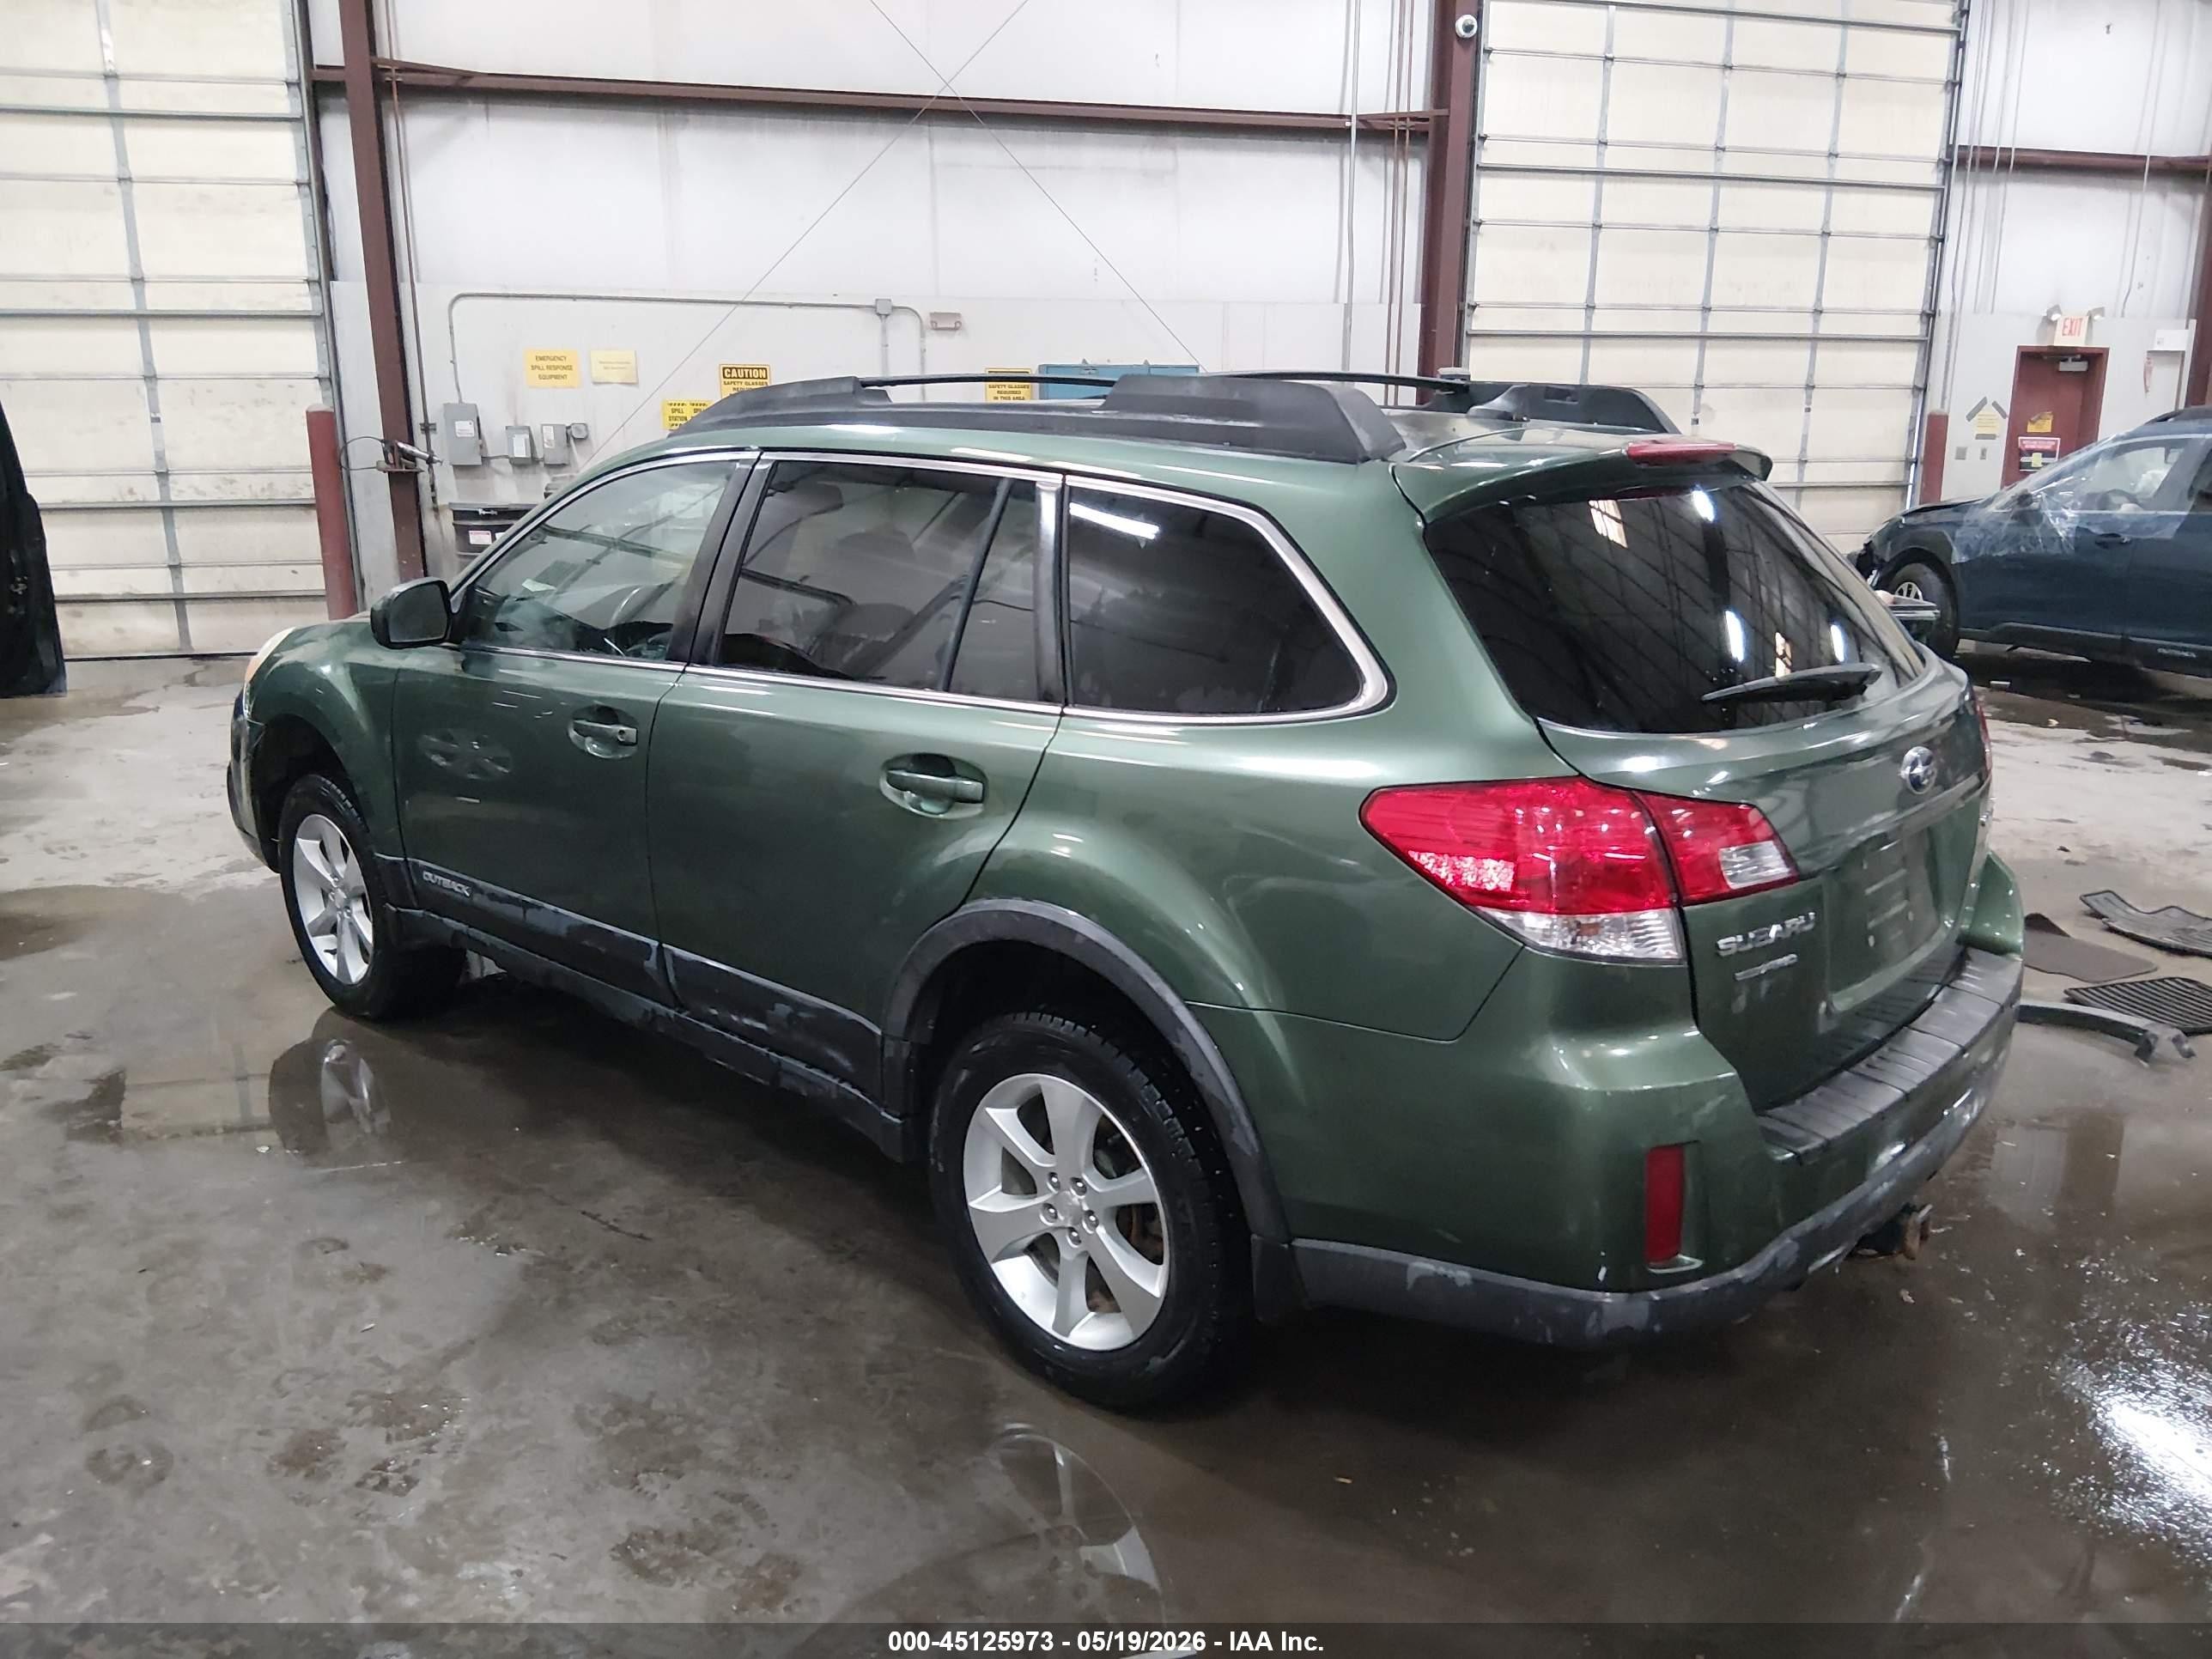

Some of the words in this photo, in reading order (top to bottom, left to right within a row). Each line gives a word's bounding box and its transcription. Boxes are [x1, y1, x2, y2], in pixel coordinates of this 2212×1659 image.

[2062, 317, 2083, 337] EXIT
[724, 368, 766, 379] CAUTION
[422, 870, 471, 897] OUTBACK
[1717, 912, 1816, 957] SUBARU
